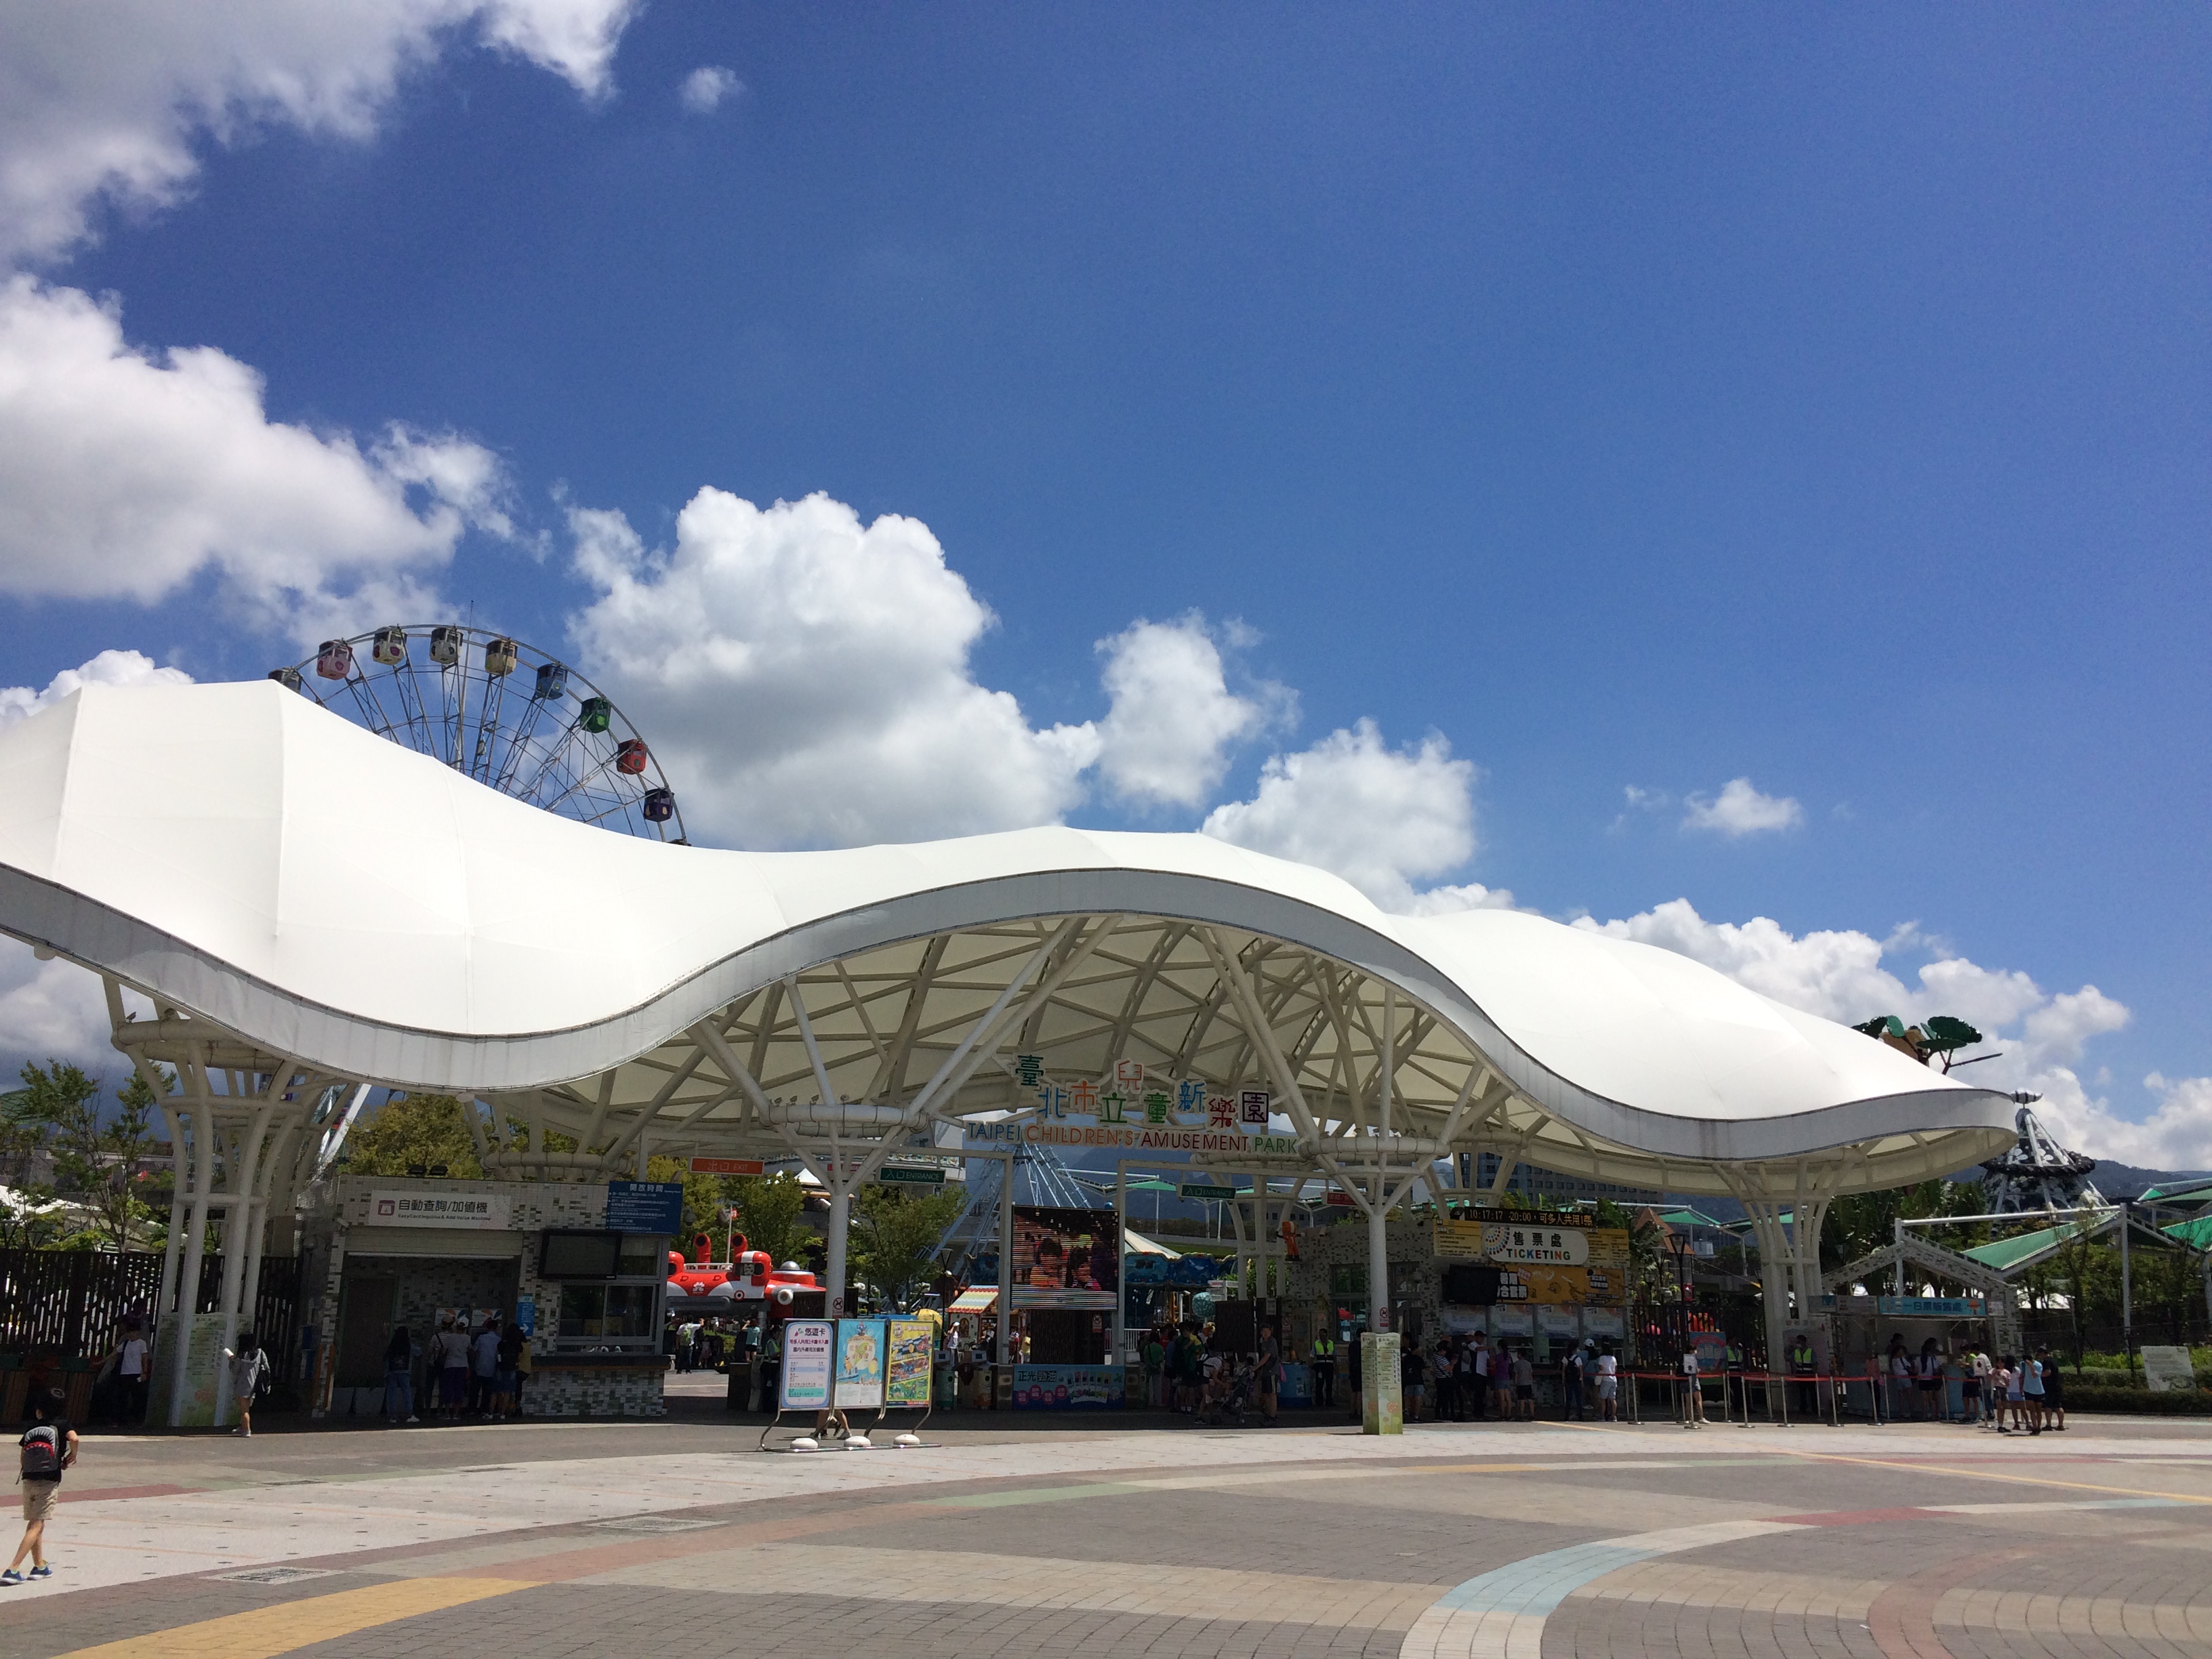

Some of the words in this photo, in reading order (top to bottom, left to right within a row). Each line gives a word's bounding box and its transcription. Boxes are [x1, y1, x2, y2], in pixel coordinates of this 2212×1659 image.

[969, 1122, 1021, 1141] TAIPEI
[1026, 1125, 1133, 1146] CHILDREN'S
[1141, 1132, 1249, 1151] AMUSEMENT
[1254, 1136, 1297, 1155] PARK
[708, 1160, 729, 1171] 出口
[885, 1169, 905, 1179] 入口
[906, 1172, 940, 1181] ENTRANCE
[398, 1199, 488, 1213] 自動查詢/加值機
[1469, 1209, 1503, 1220] 10:17:17
[1513, 1231, 1562, 1248] 售票處
[1507, 1248, 1570, 1261] TICKETING
